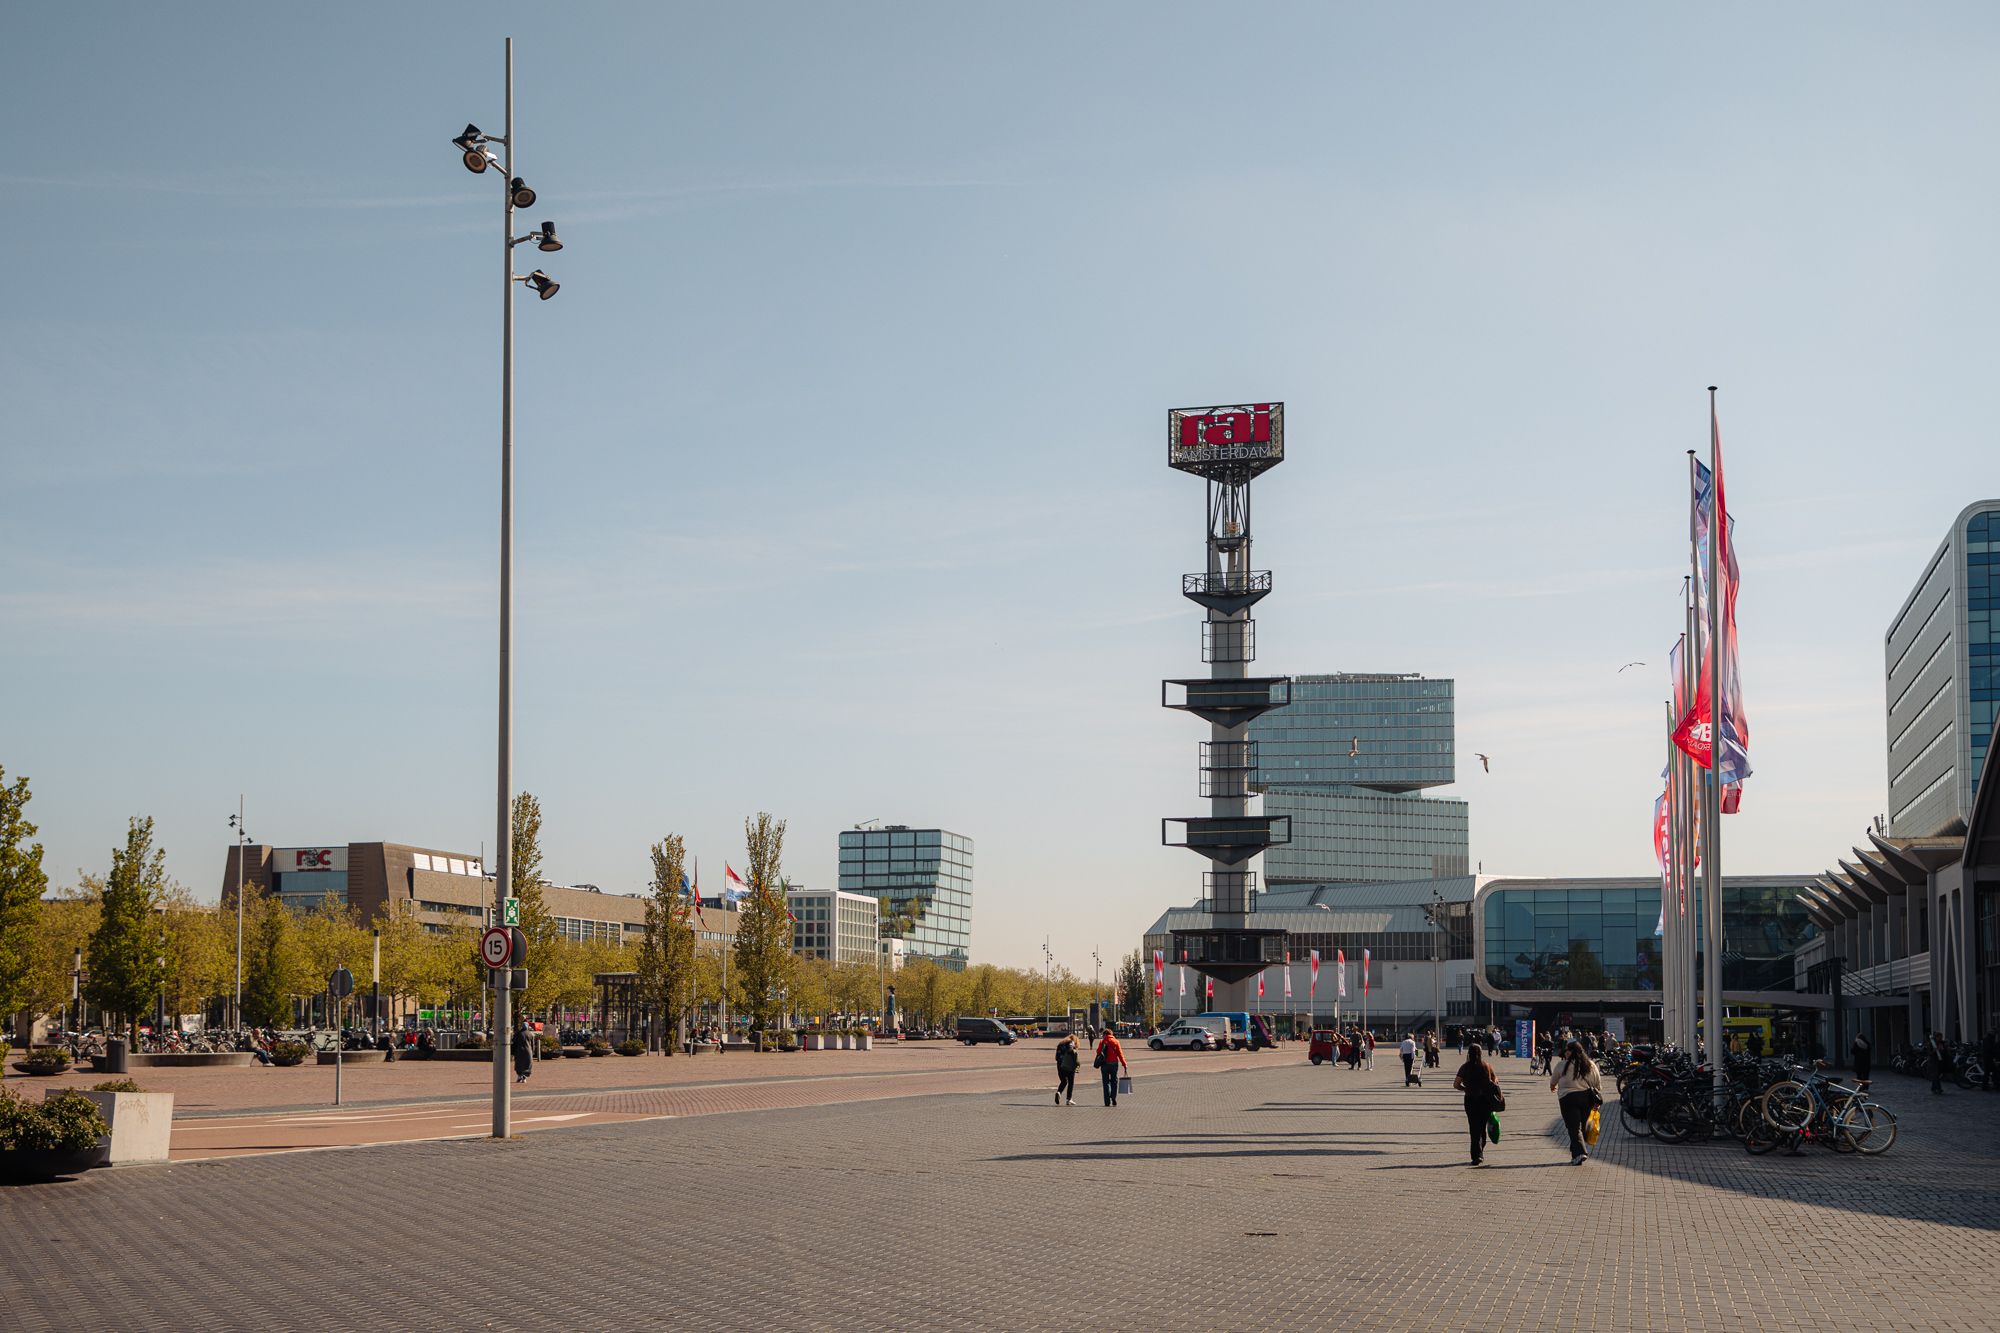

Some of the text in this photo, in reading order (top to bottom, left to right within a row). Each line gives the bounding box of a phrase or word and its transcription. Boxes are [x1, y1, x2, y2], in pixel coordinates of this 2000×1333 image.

[1181, 403, 1270, 446] rai
[1181, 447, 1270, 461] AMSTERDAM
[489, 940, 503, 955] 15
